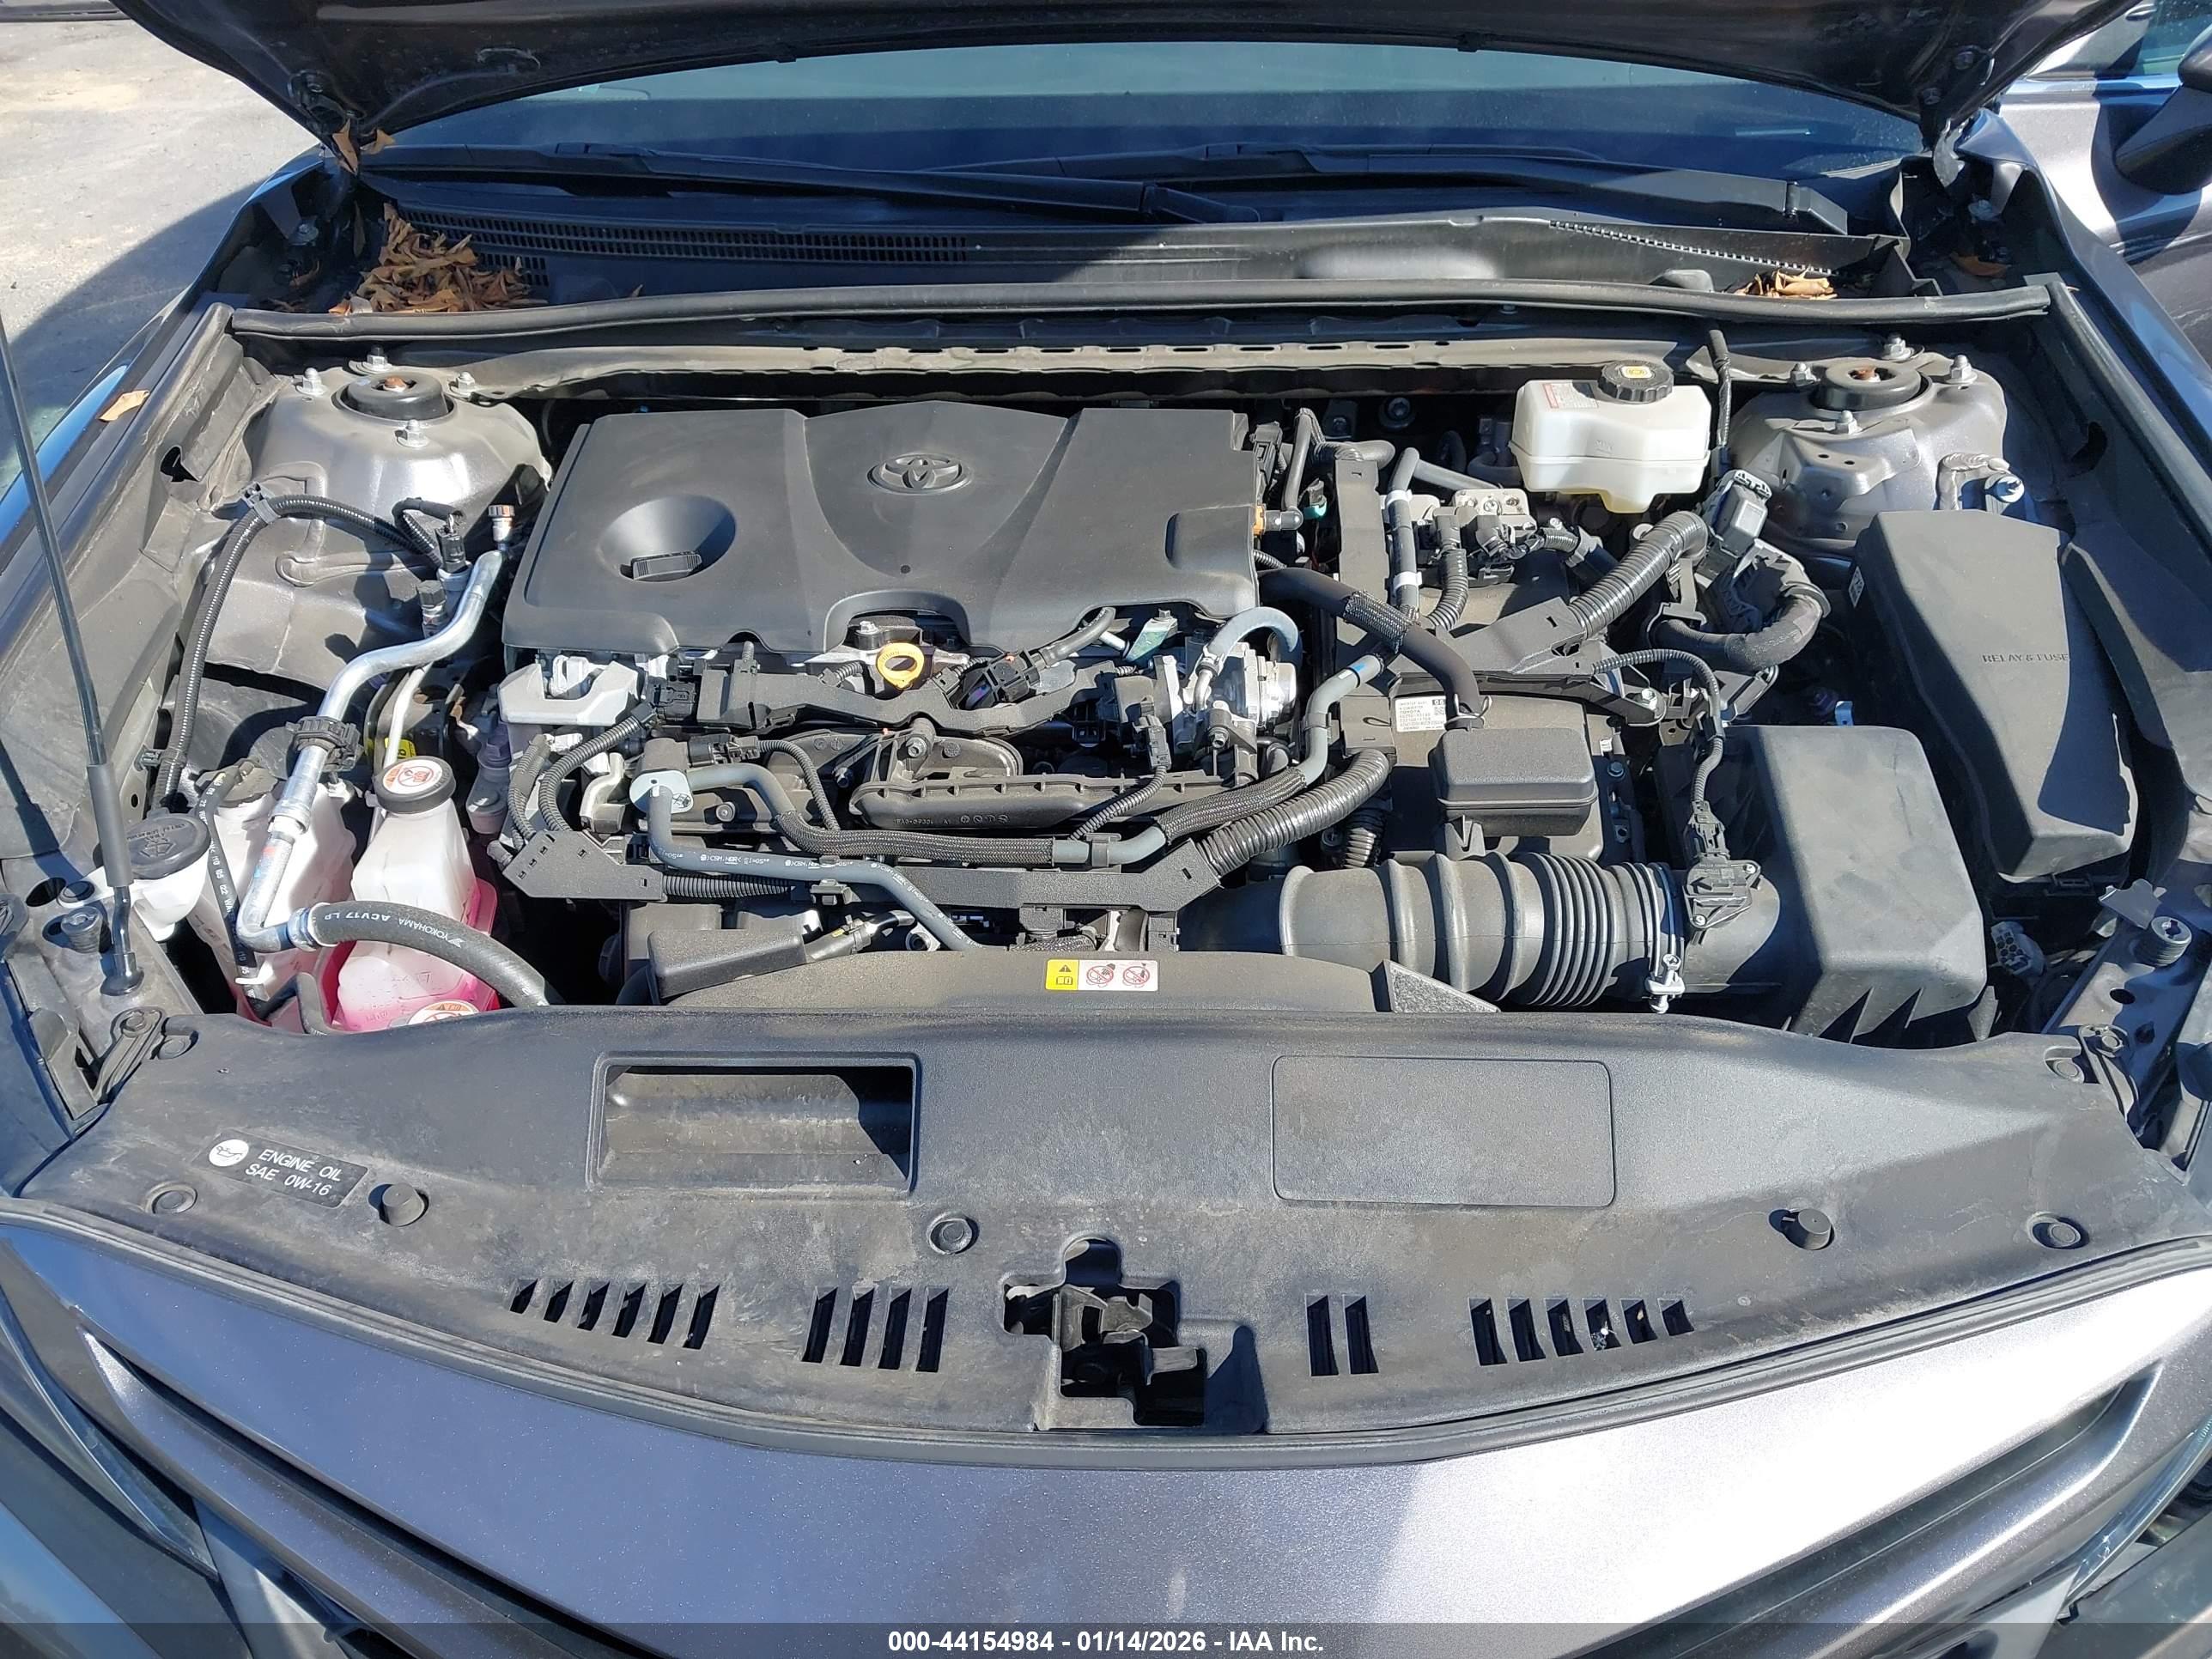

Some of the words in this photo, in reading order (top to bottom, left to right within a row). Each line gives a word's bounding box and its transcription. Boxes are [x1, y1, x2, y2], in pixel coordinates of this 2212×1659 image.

[1982, 653, 2022, 663] RELAY
[324, 912, 340, 921] LP
[345, 911, 391, 921] ACV17
[398, 918, 448, 939] YOKOHAMA
[258, 1149, 315, 1173] ENGINE
[319, 1166, 343, 1182] OIL
[245, 1163, 280, 1181] SAE
[283, 1174, 332, 1196] 0W-16
